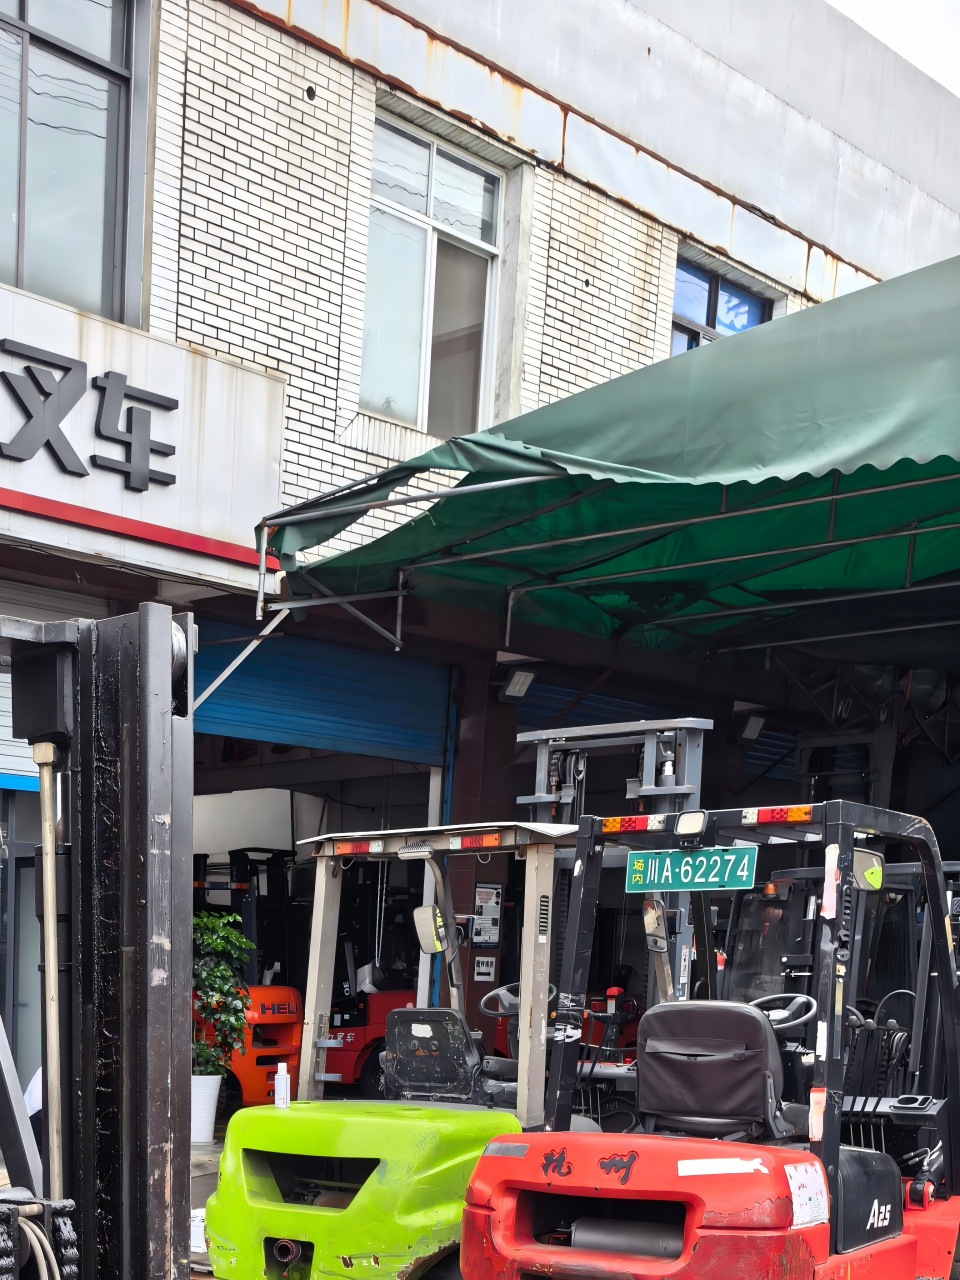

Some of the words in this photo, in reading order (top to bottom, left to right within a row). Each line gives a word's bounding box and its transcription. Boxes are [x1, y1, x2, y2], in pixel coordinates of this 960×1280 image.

[632, 859, 644, 884] 场内
[646, 854, 749, 884] 川A·62274
[866, 1199, 892, 1230] A25
